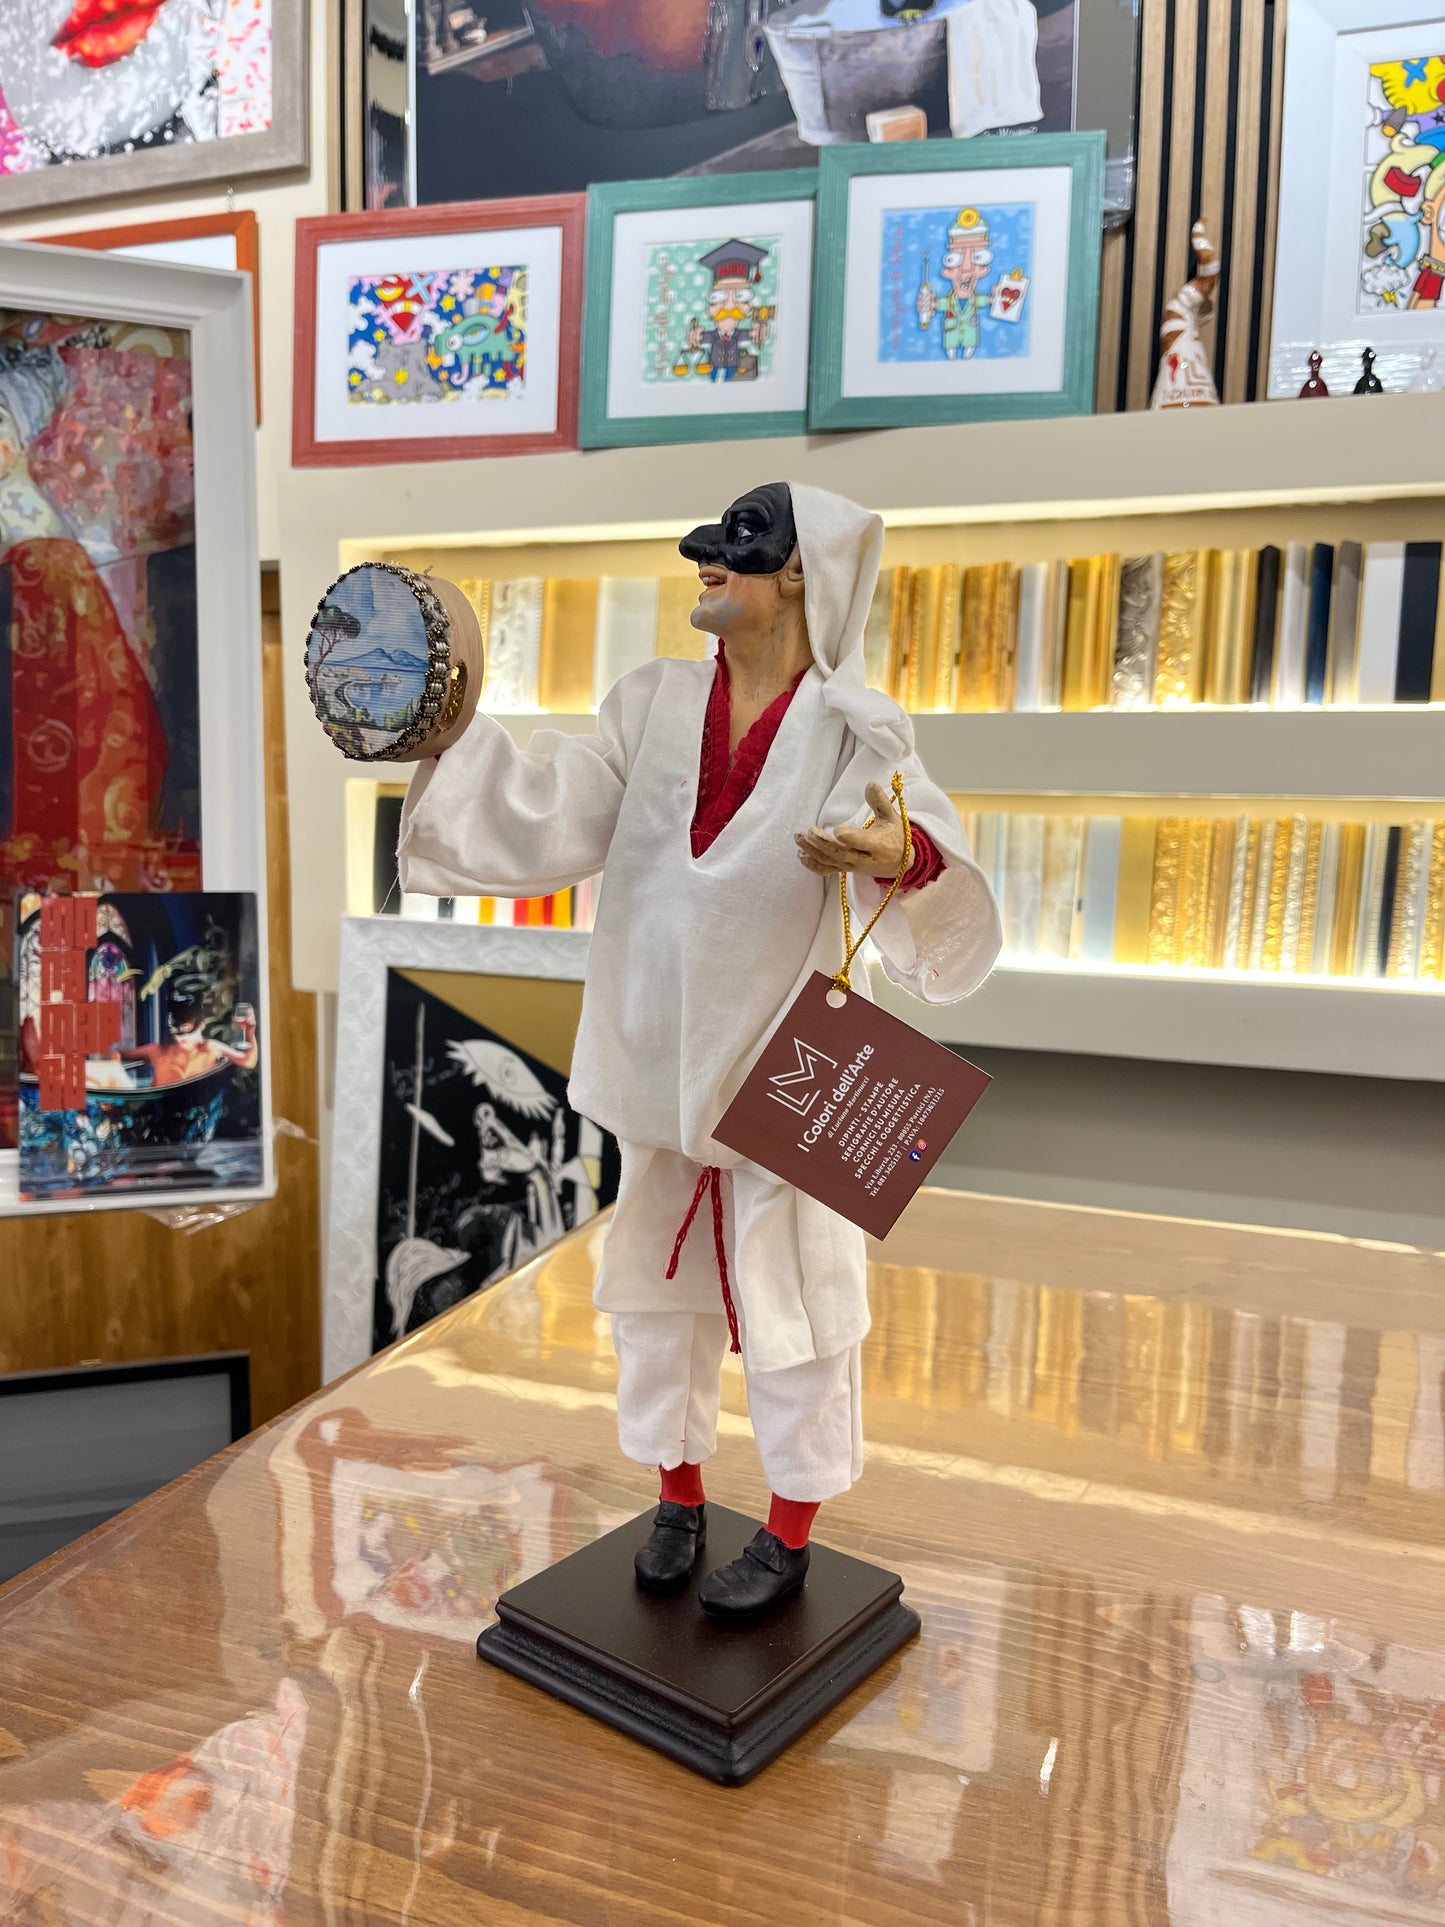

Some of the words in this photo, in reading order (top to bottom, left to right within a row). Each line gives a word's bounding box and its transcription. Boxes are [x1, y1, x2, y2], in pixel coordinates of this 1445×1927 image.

[831, 1044, 875, 1103] dell'Arte
[803, 1100, 838, 1144] Colori
[827, 1130, 834, 1139] di
[831, 1108, 850, 1132] Luciano
[837, 1117, 861, 1148] DIPINTI
[860, 1081, 884, 1113] STAMPE
[841, 1115, 874, 1162] SERIGRAFIE
[870, 1077, 899, 1117] D'AUTORE
[852, 1129, 878, 1163] CORNICI
[874, 1118, 885, 1130] SU
[881, 1088, 906, 1119] MISURA
[854, 1145, 880, 1179] SPECCHI
[875, 1139, 884, 1147] E
[880, 1083, 921, 1140] OGGETTISTICA
[864, 1178, 875, 1189] Via
[887, 1143, 898, 1156] 233
[908, 1101, 926, 1124] Portici
[922, 1087, 937, 1104] (NA)
[797, 1143, 810, 1153] I
[869, 1186, 881, 1197] Tel.
